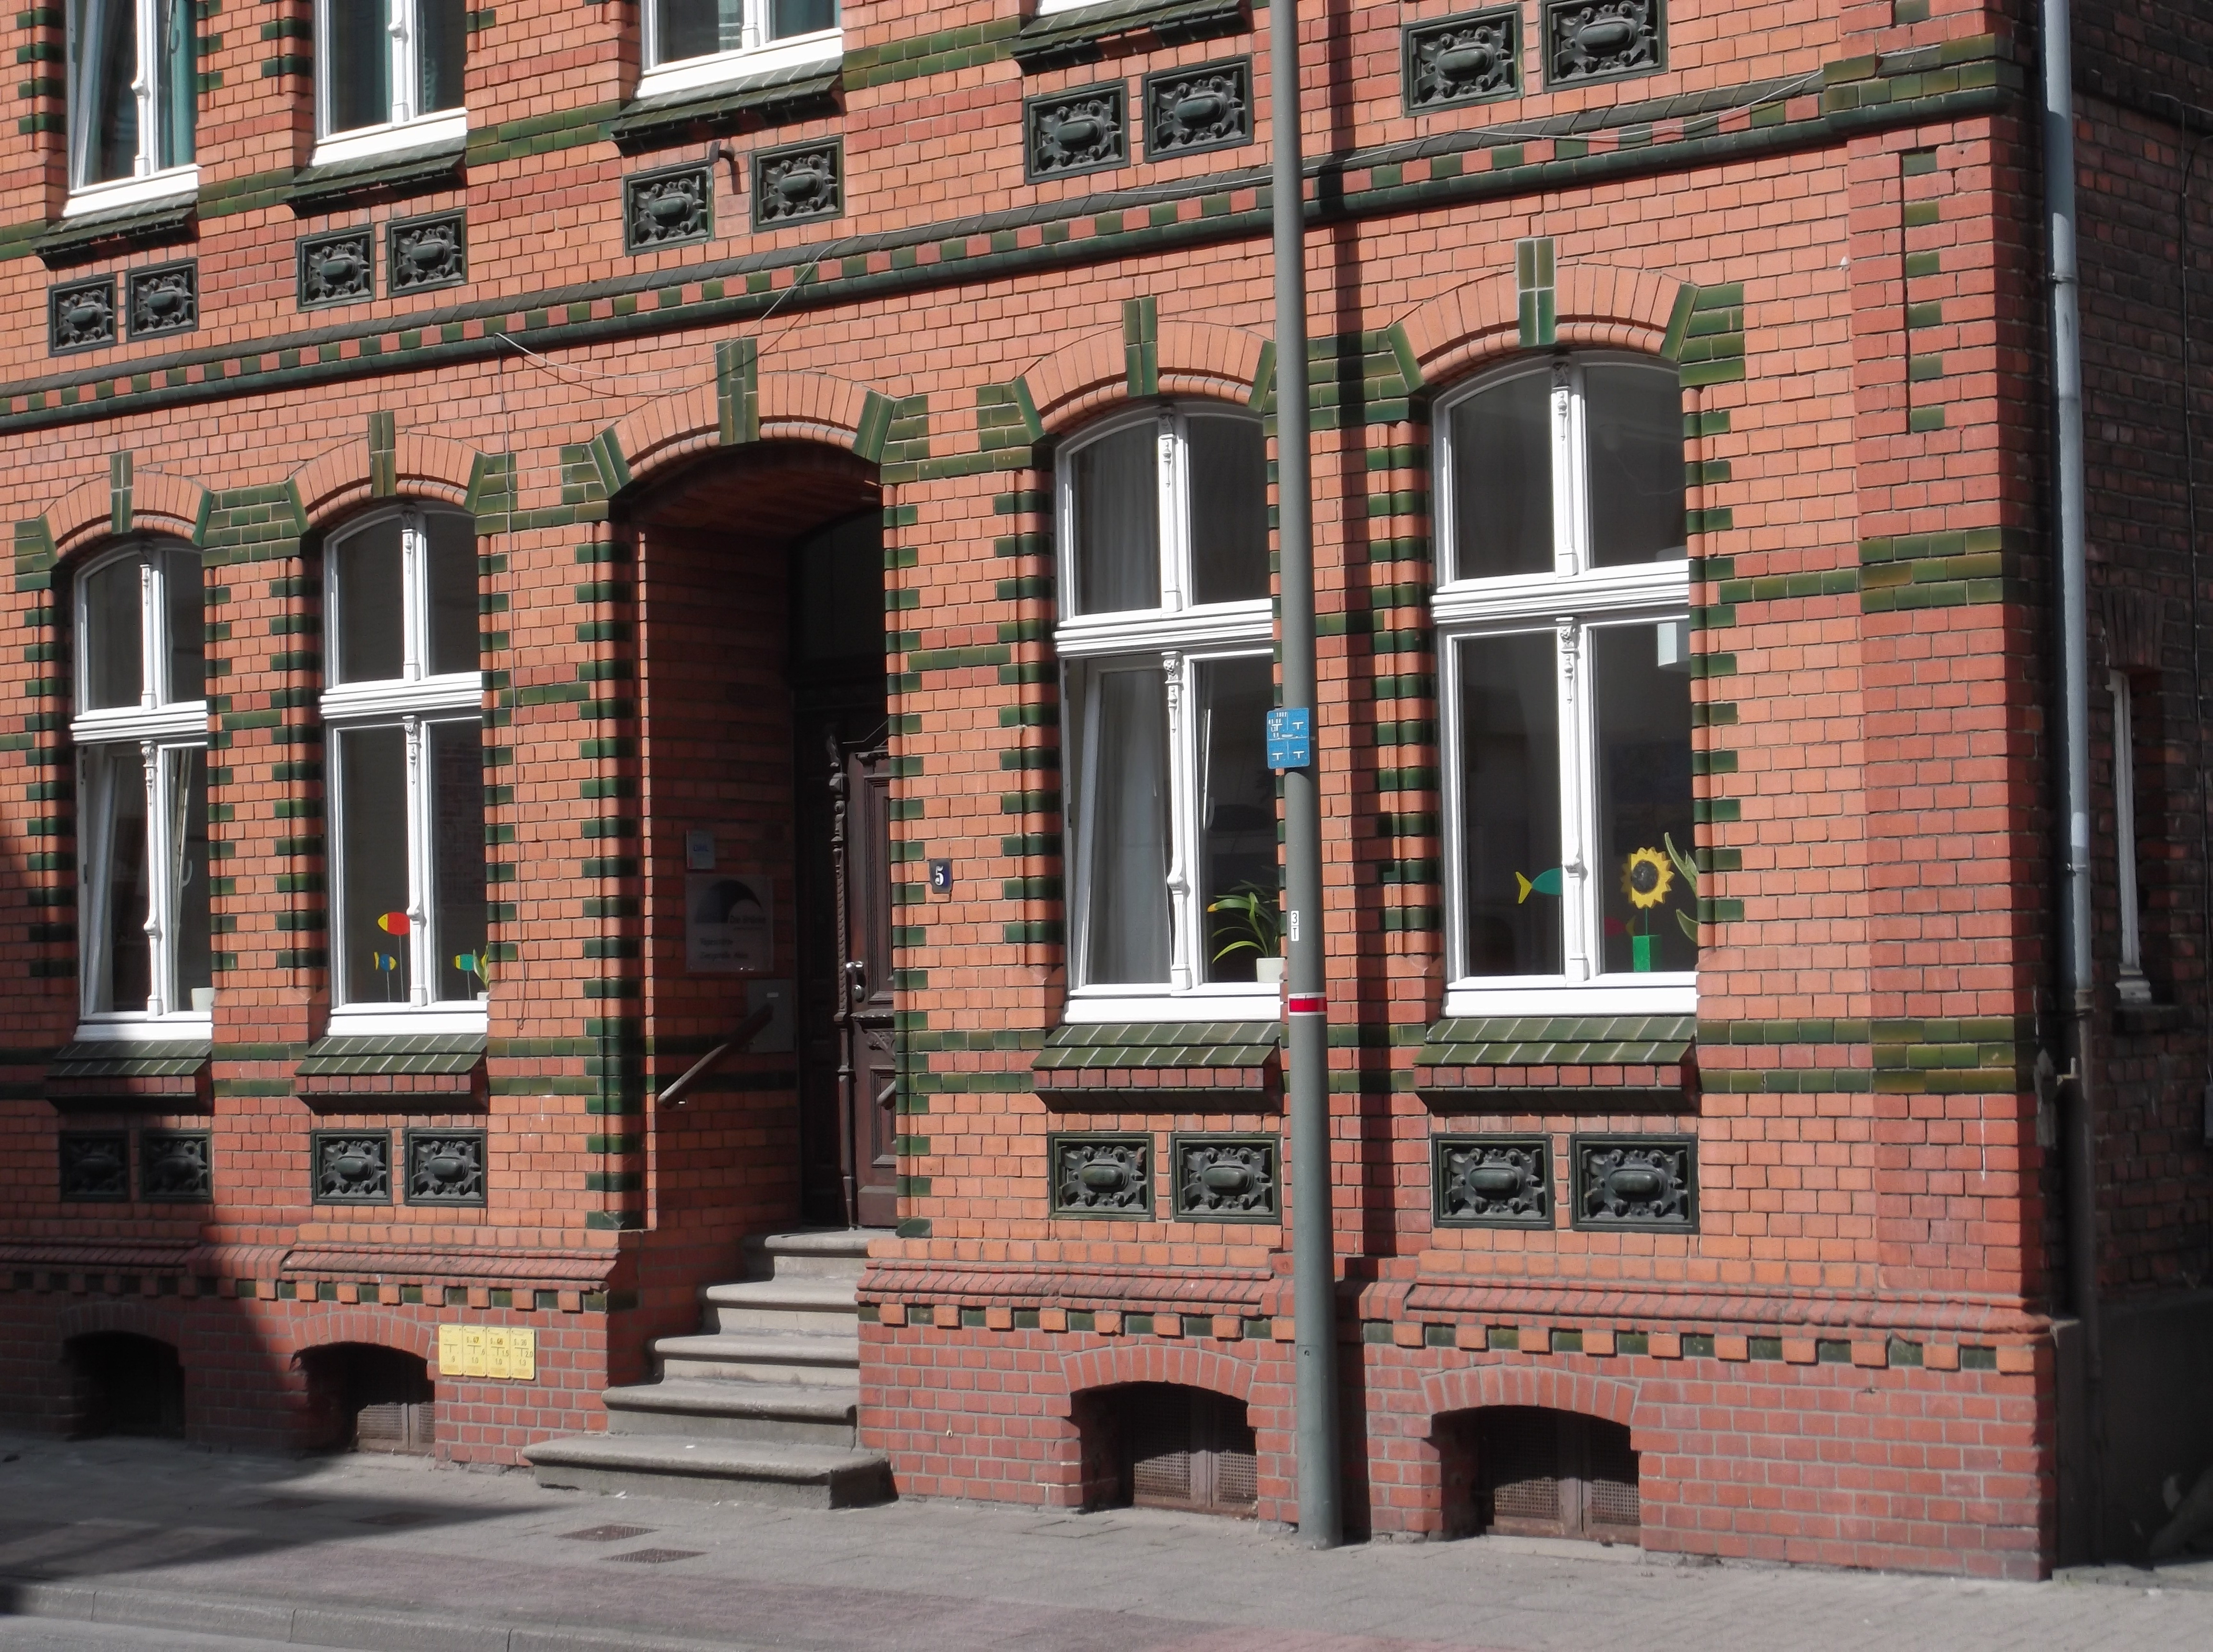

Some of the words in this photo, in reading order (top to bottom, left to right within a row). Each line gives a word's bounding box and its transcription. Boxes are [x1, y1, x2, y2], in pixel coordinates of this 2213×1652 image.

[935, 865, 944, 886] 5
[1292, 912, 1298, 924] 3
[1292, 927, 1297, 940] T
